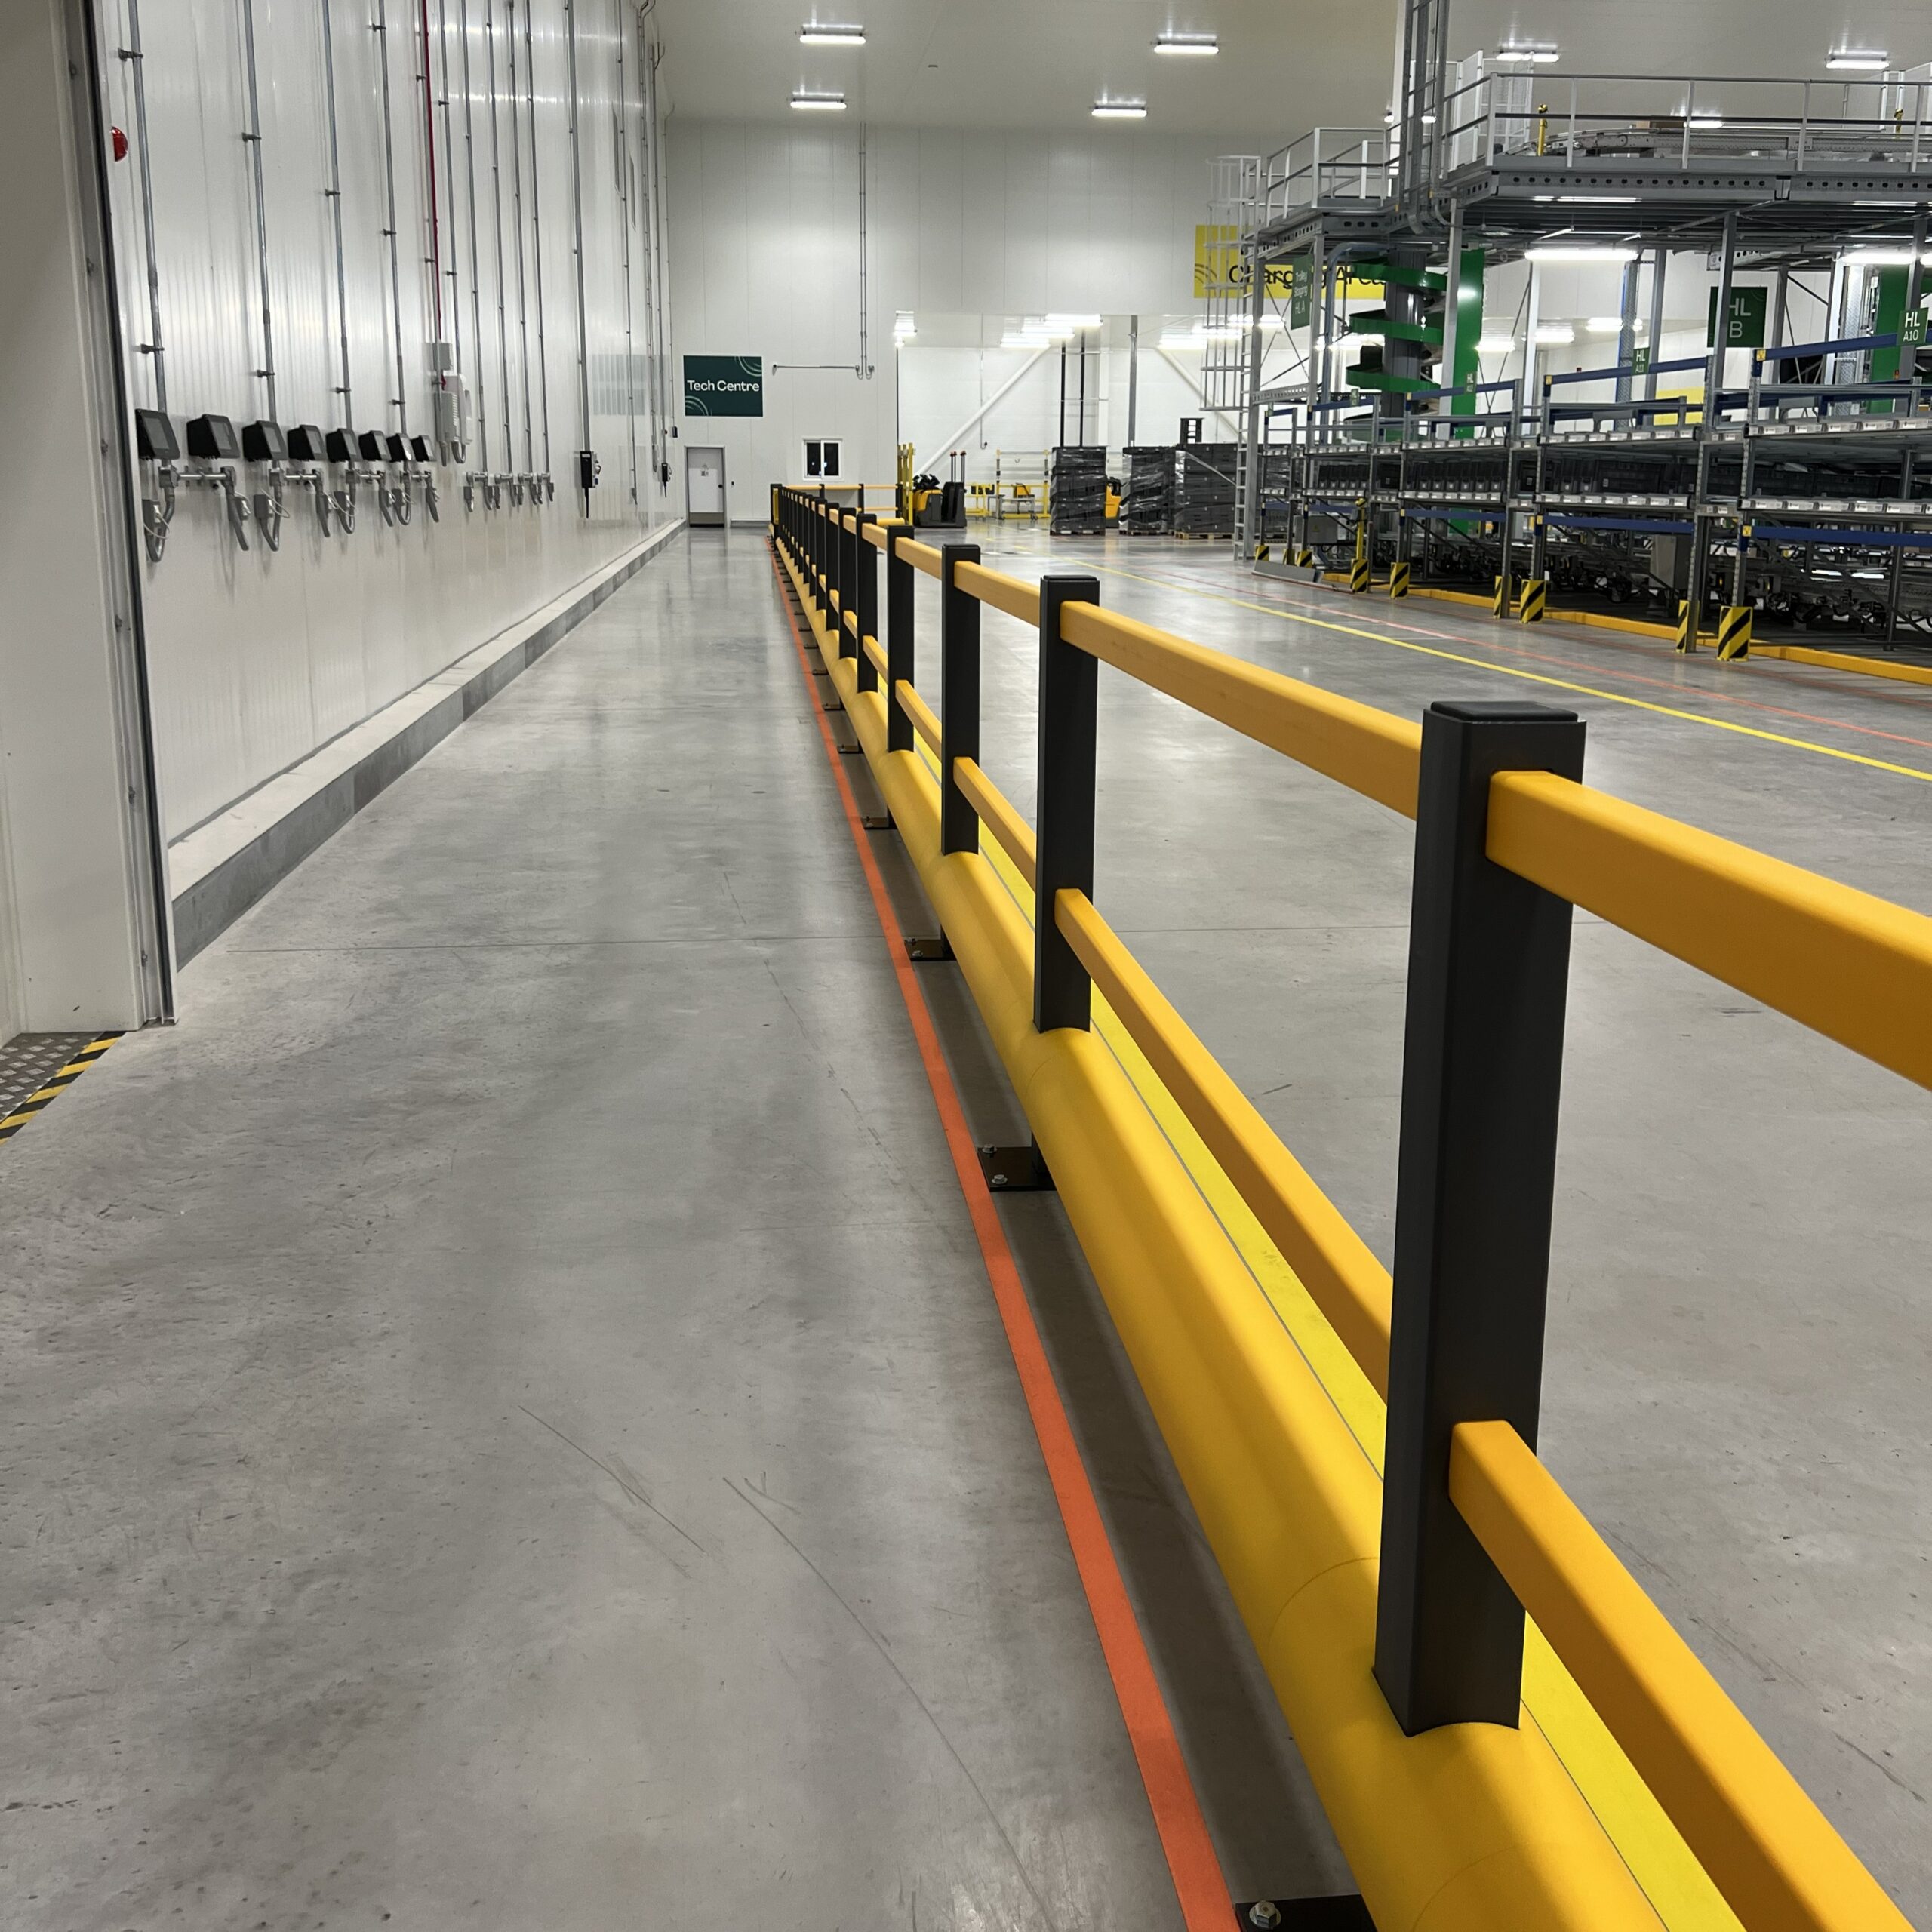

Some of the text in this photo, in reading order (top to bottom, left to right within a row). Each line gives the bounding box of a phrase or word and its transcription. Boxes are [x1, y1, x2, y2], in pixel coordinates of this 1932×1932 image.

[1229, 265, 1326, 289] Carg
[1729, 297, 1751, 316] HL
[1905, 311, 1921, 328] HL
[1729, 321, 1743, 338] B
[1902, 329, 1919, 342] A10
[1635, 349, 1646, 362] HL
[687, 380, 760, 392] Tech Centre
